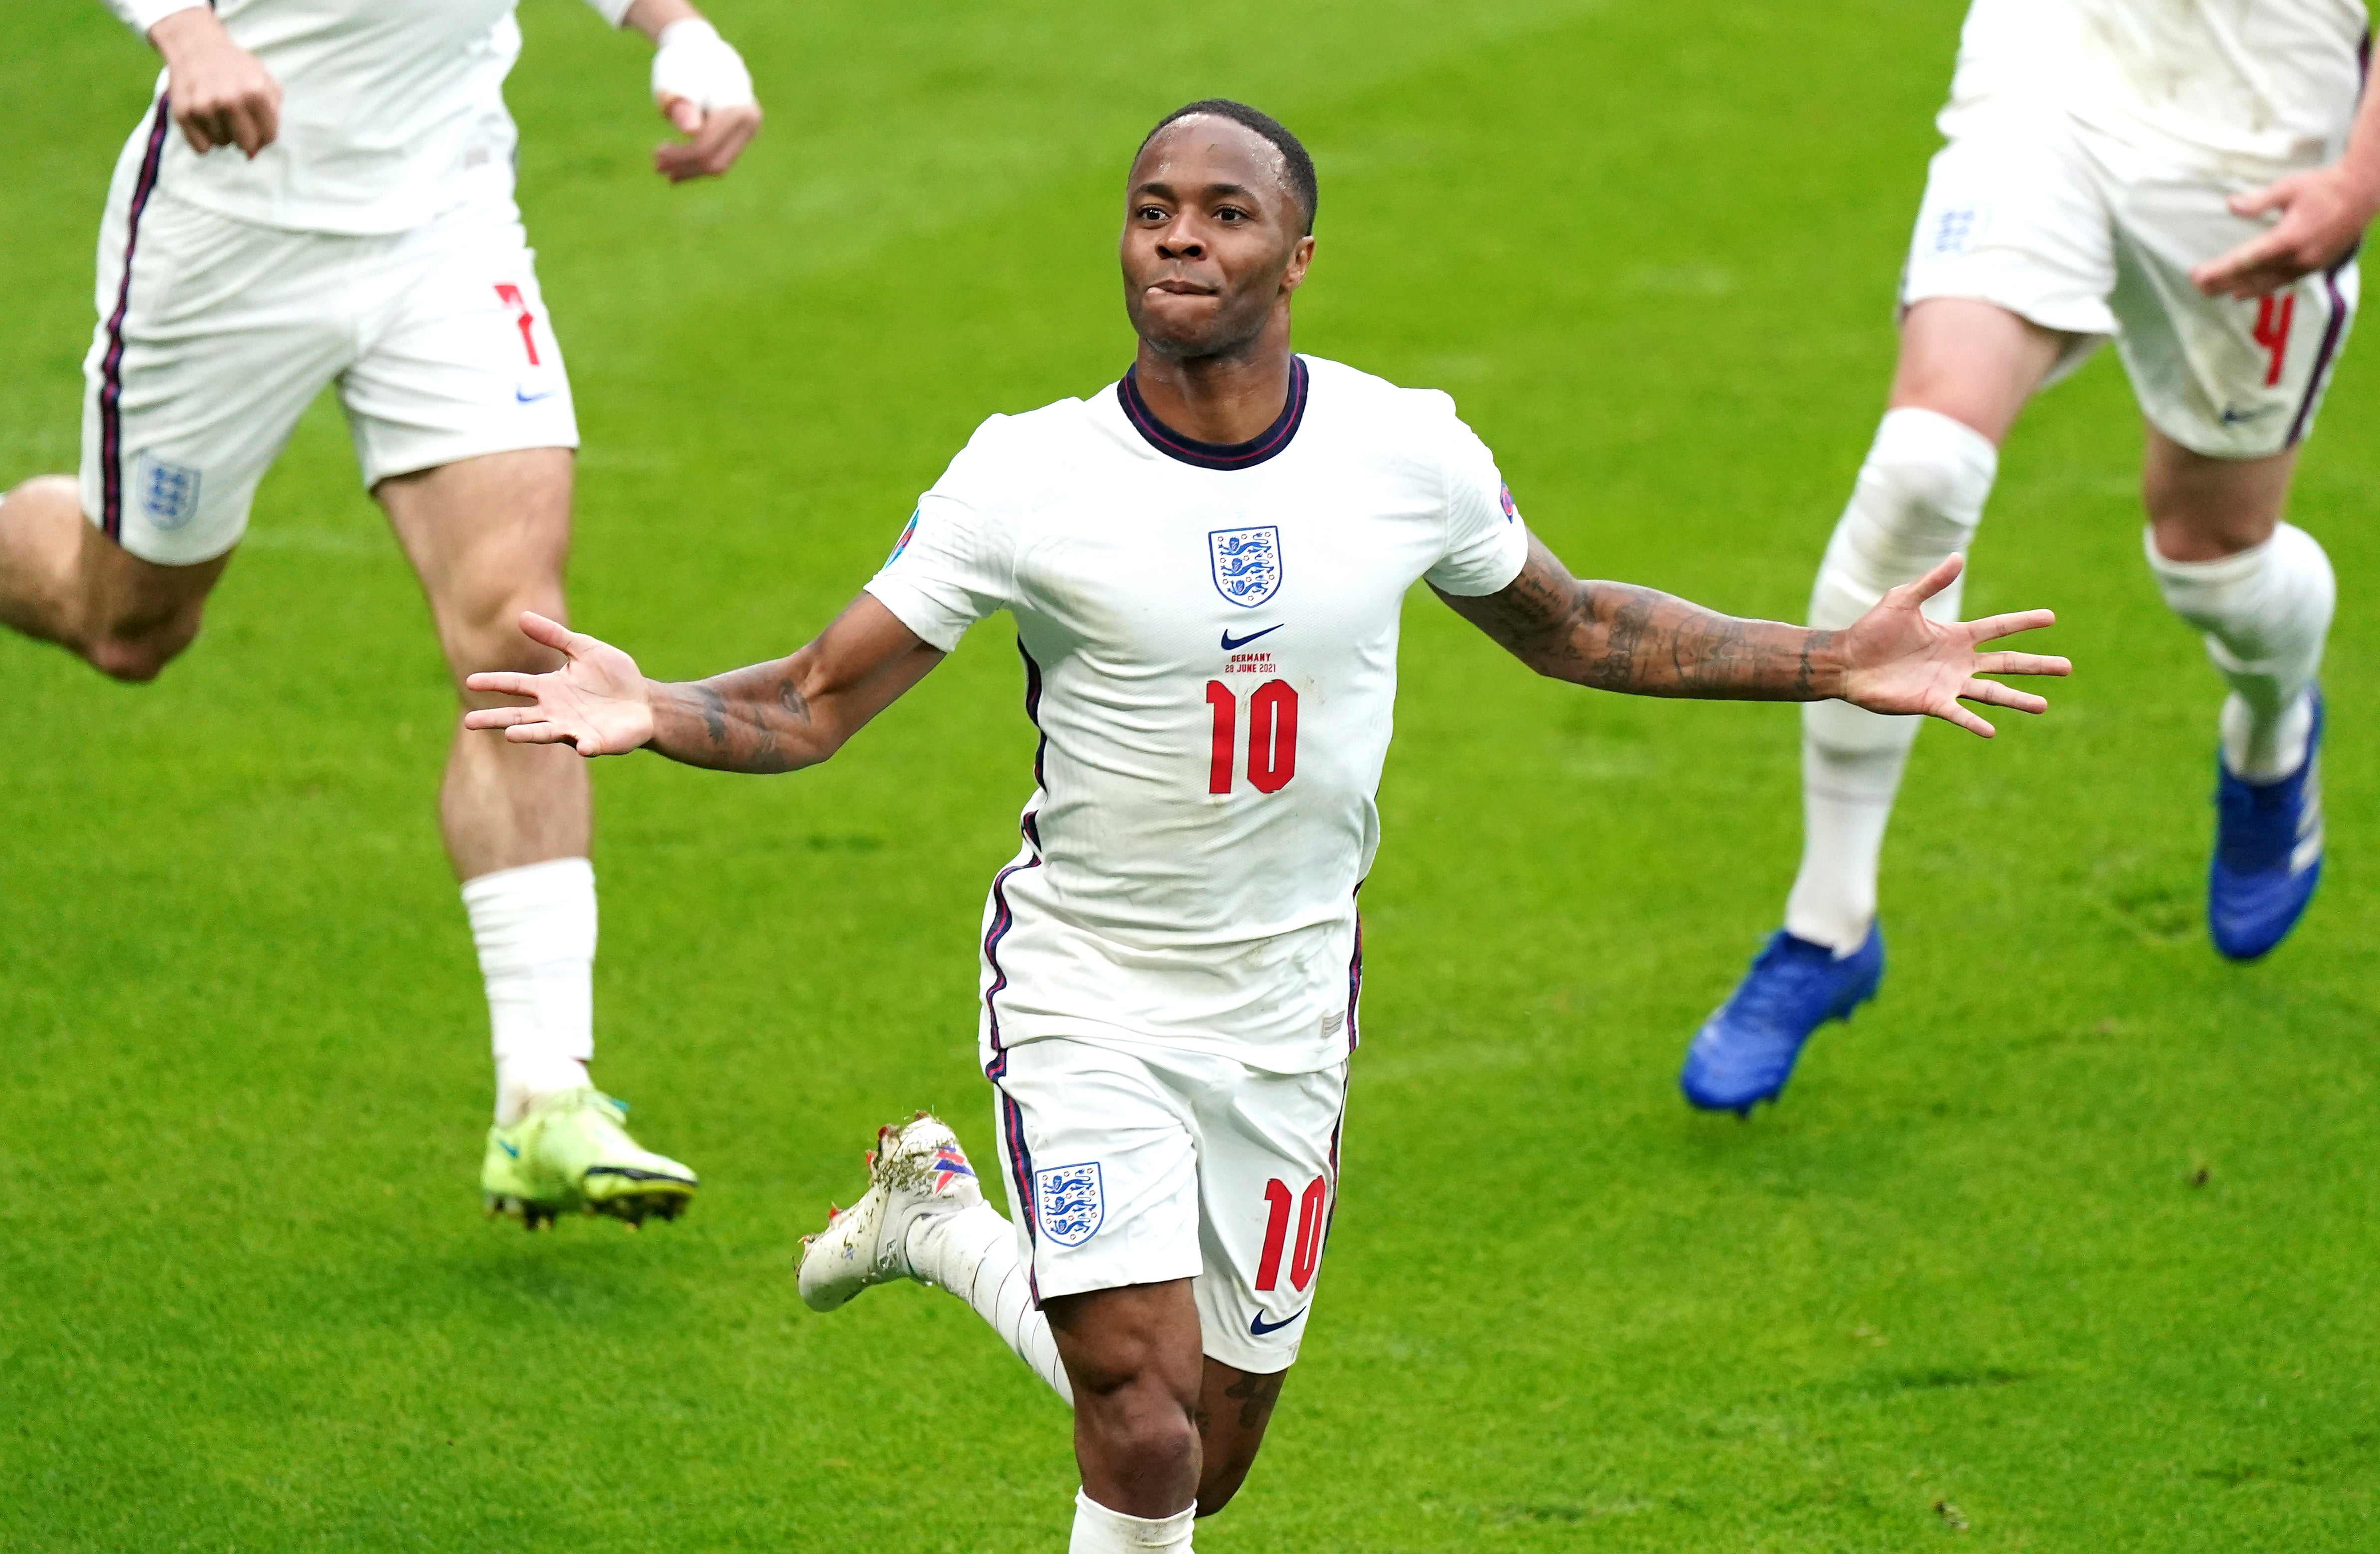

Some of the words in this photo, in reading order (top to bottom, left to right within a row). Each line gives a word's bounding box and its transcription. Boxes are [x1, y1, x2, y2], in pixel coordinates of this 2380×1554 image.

[2253, 292, 2295, 386] 4
[1231, 653, 1271, 662] GERMANY
[1237, 664, 1257, 672] JUNE
[1259, 663, 1276, 673] 2021
[1206, 679, 1298, 794] 10
[1255, 1175, 1325, 1292] 10
